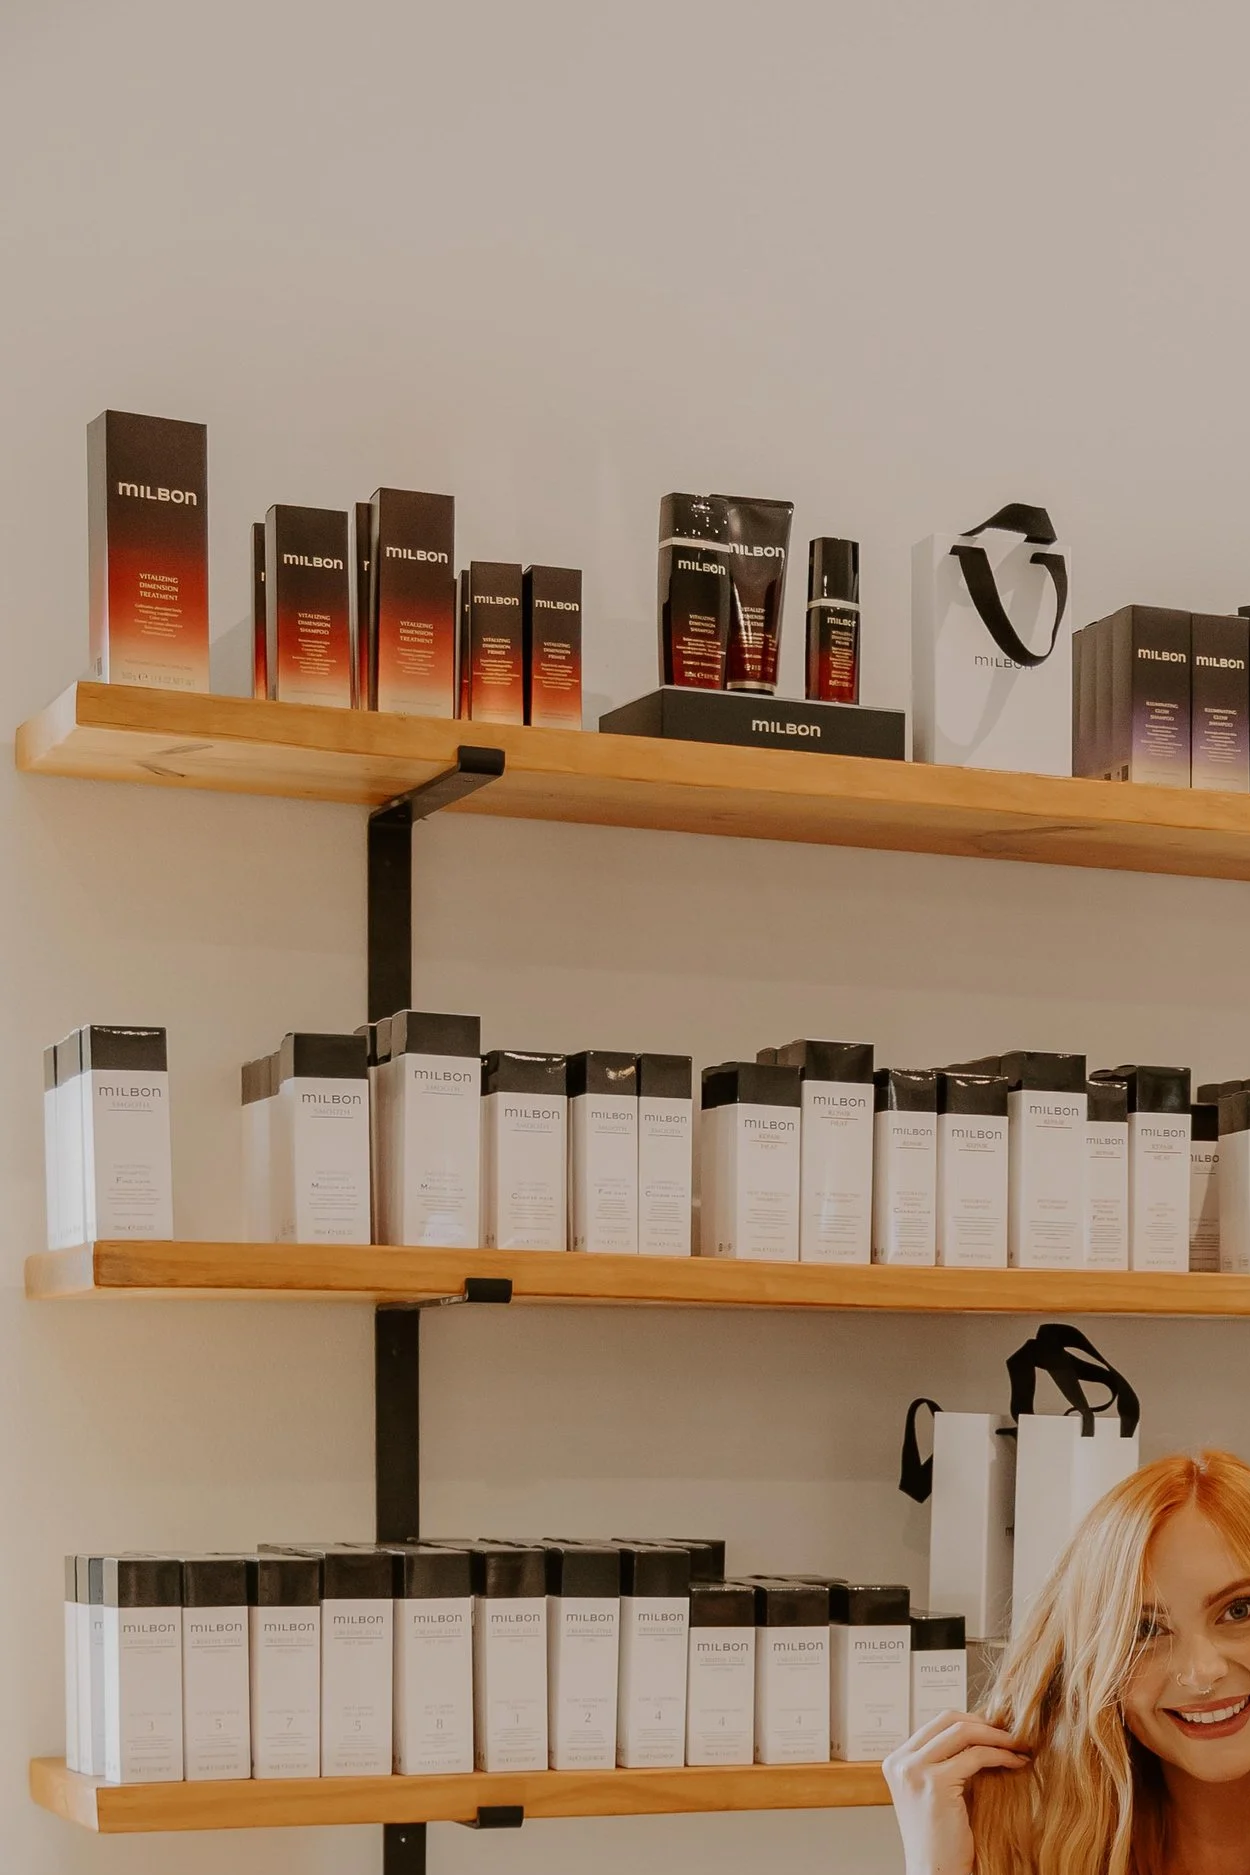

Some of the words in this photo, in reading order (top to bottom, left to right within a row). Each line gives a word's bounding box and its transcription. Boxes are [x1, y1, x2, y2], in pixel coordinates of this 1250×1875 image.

[139, 573, 179, 584] VITALIZING
[139, 582, 179, 593] DIMENSION
[139, 590, 179, 601] TREATMENT
[299, 627, 330, 636] SHAMPOO
